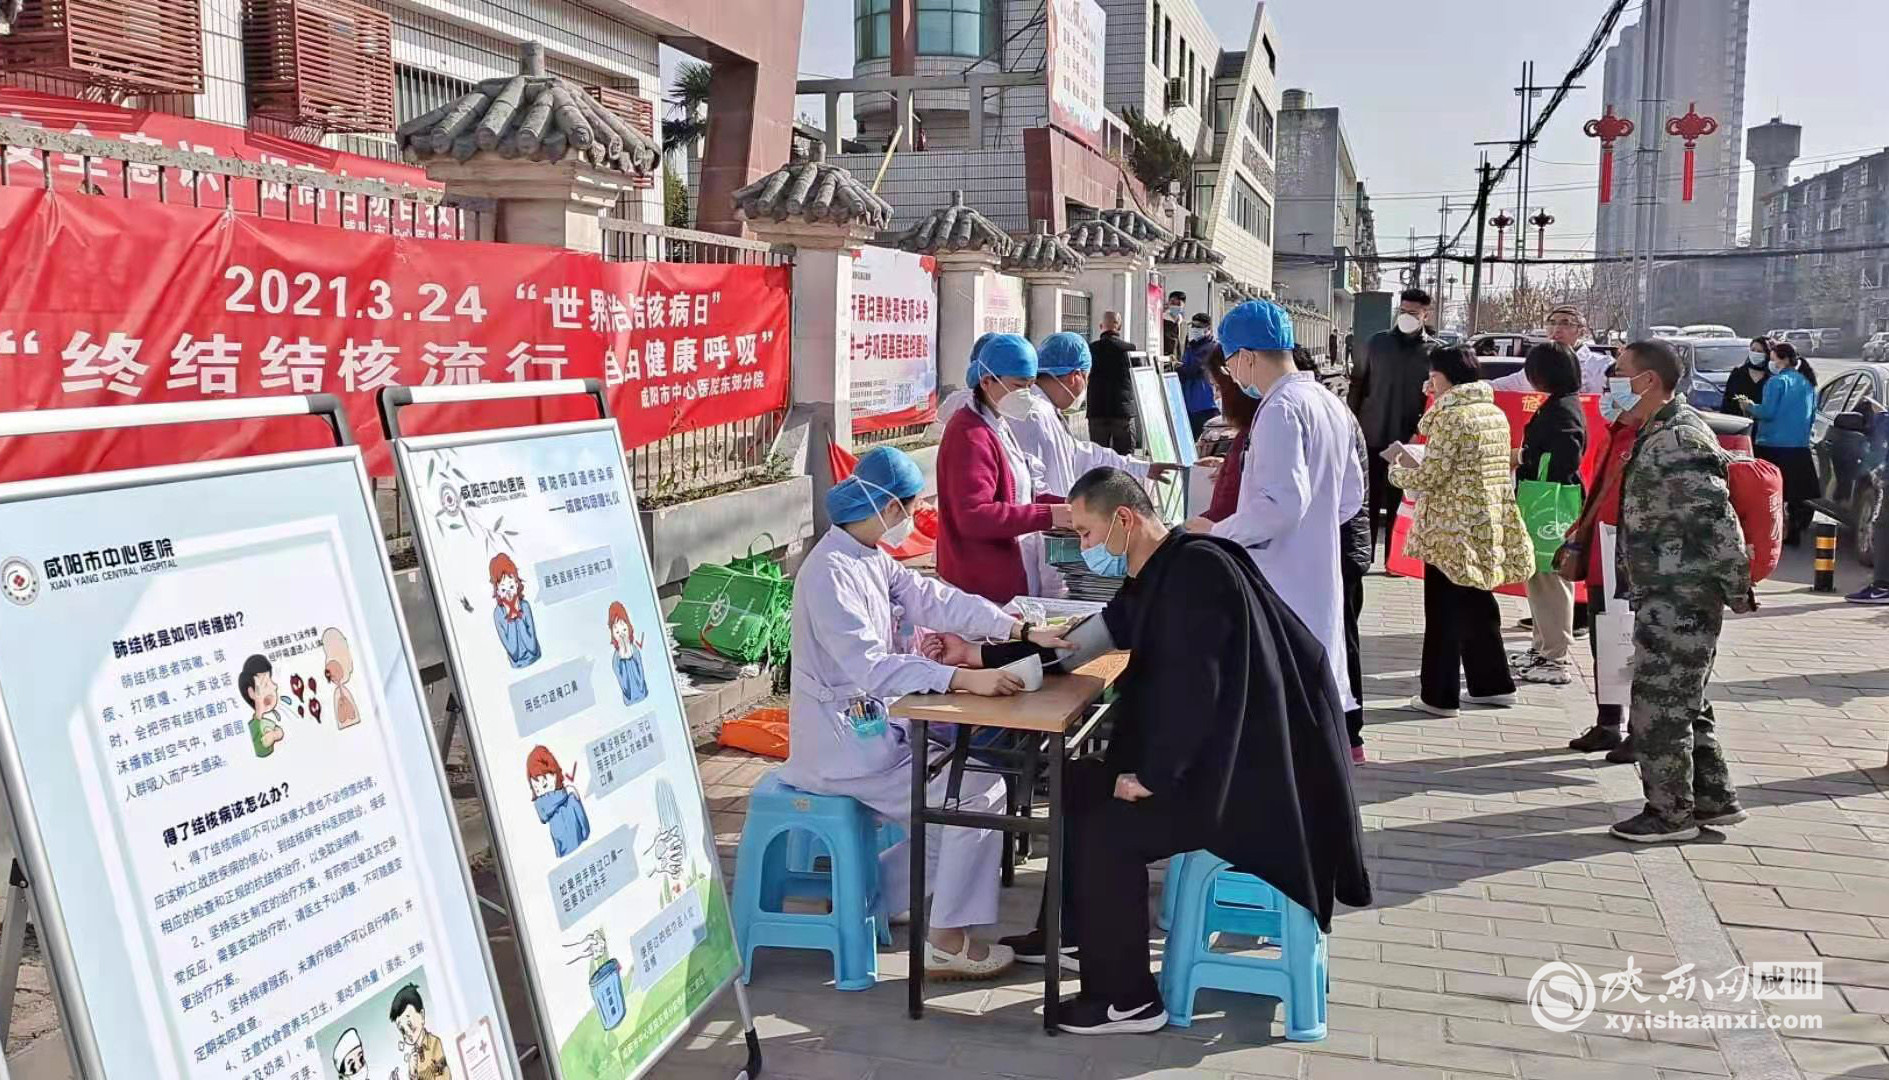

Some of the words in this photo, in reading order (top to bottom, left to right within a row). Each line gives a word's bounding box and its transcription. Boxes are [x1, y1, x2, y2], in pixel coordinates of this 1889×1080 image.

[225, 265, 487, 323] 2021.3.24
[640, 370, 765, 409] 咸阳市中心医院东郊分院
[43, 537, 175, 580] 咸阳市中心医院
[50, 579, 72, 592] XIAN
[75, 573, 99, 587] YANG
[102, 567, 138, 582] CENTRAL
[141, 559, 178, 574] HOSPITAL
